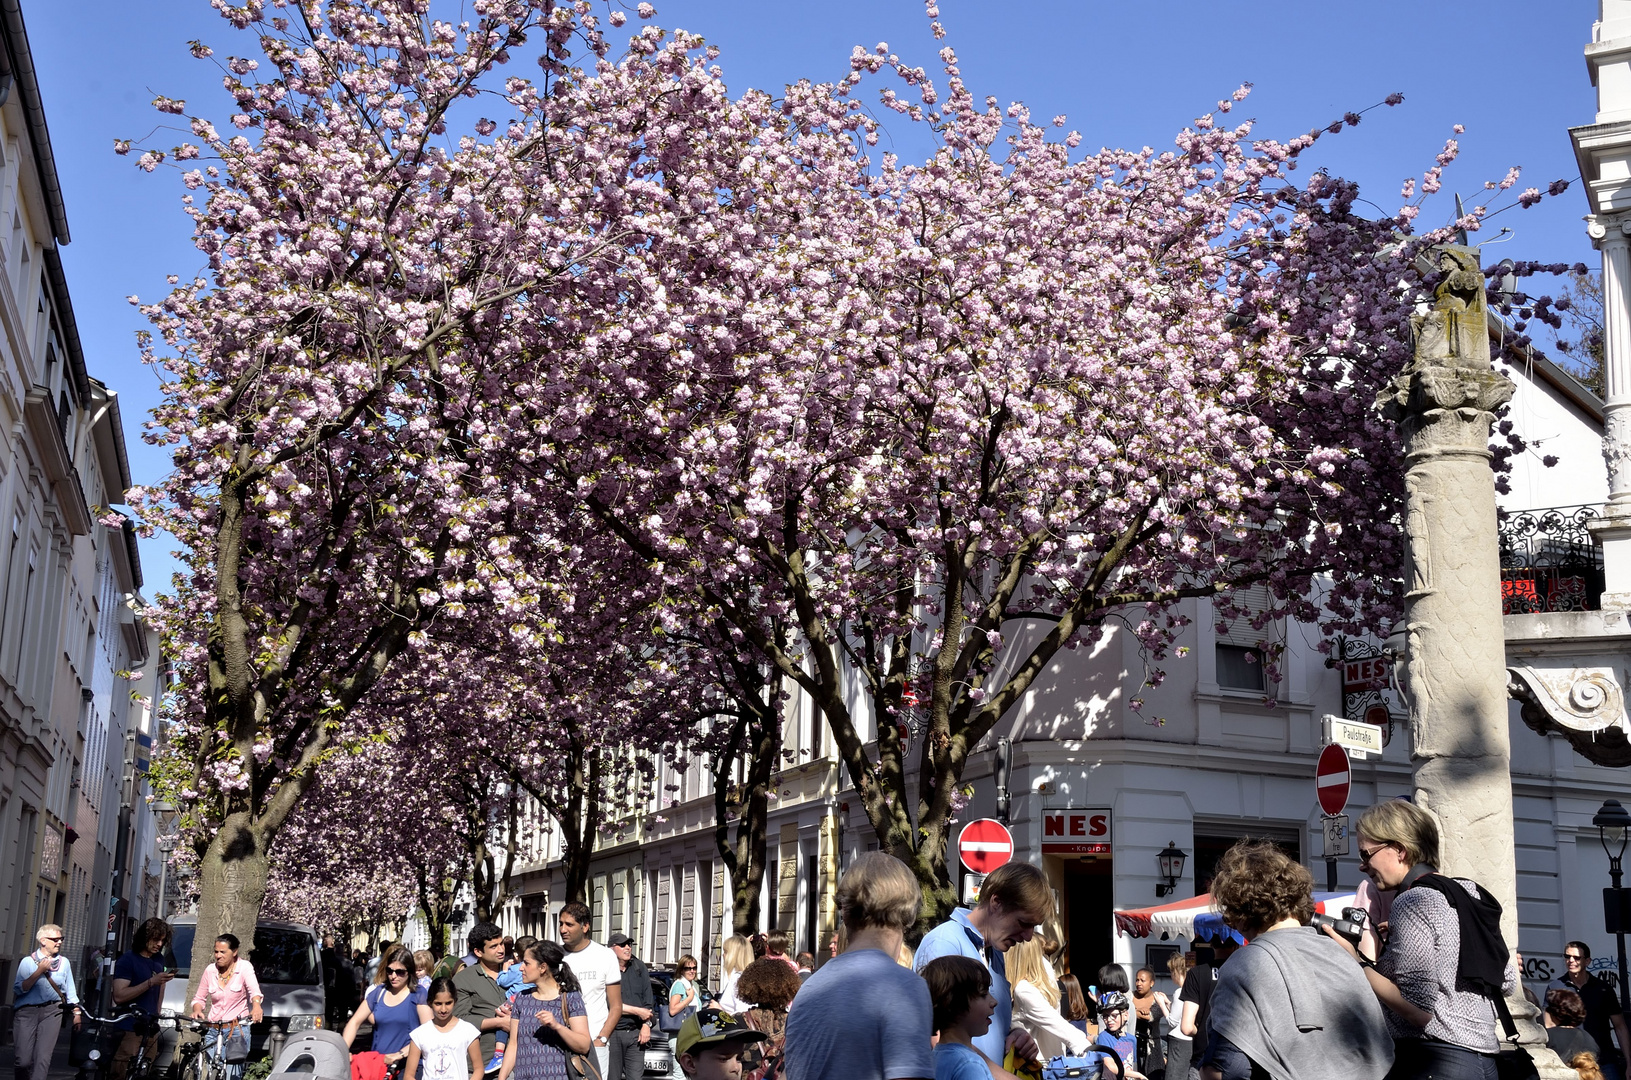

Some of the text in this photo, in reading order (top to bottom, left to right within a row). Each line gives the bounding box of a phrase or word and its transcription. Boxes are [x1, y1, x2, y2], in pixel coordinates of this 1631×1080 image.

[1347, 659, 1385, 681] NES
[1343, 726, 1371, 744] Paulstraße
[1045, 815, 1107, 836] NES
[575, 970, 597, 981] CTER
[653, 1061, 667, 1070] 186
